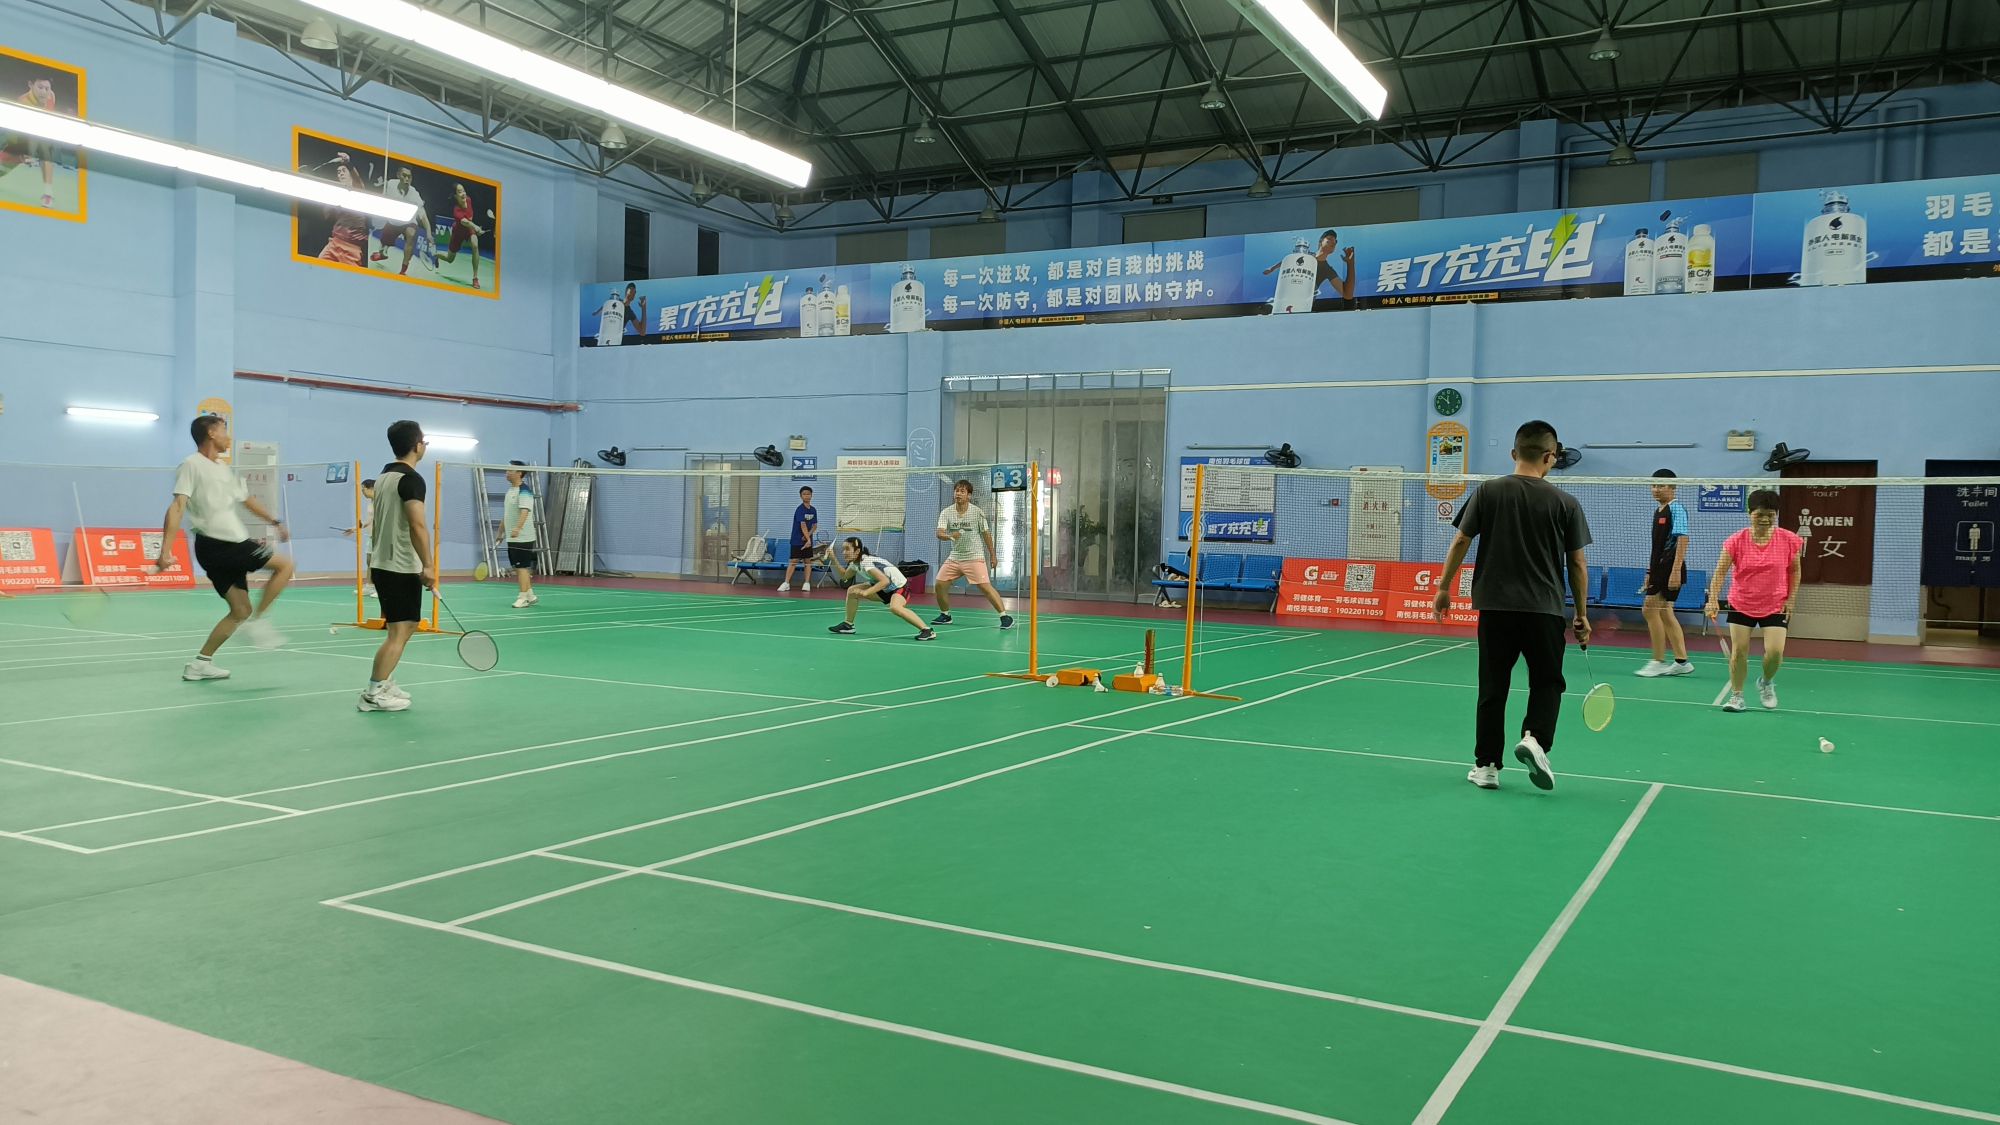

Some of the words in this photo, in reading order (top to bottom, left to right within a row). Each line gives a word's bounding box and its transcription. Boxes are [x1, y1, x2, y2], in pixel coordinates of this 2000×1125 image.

[1924, 191, 2000, 221] 羽毛
[1922, 228, 2000, 257] 都是
[337, 467, 347, 481] 4
[1009, 469, 1023, 488] 3
[1957, 486, 1998, 498] 洗手间
[1798, 515, 1854, 526] WOMEN
[1818, 536, 1847, 558] 女
[1305, 566, 1318, 581] G
[1415, 570, 1431, 585] G
